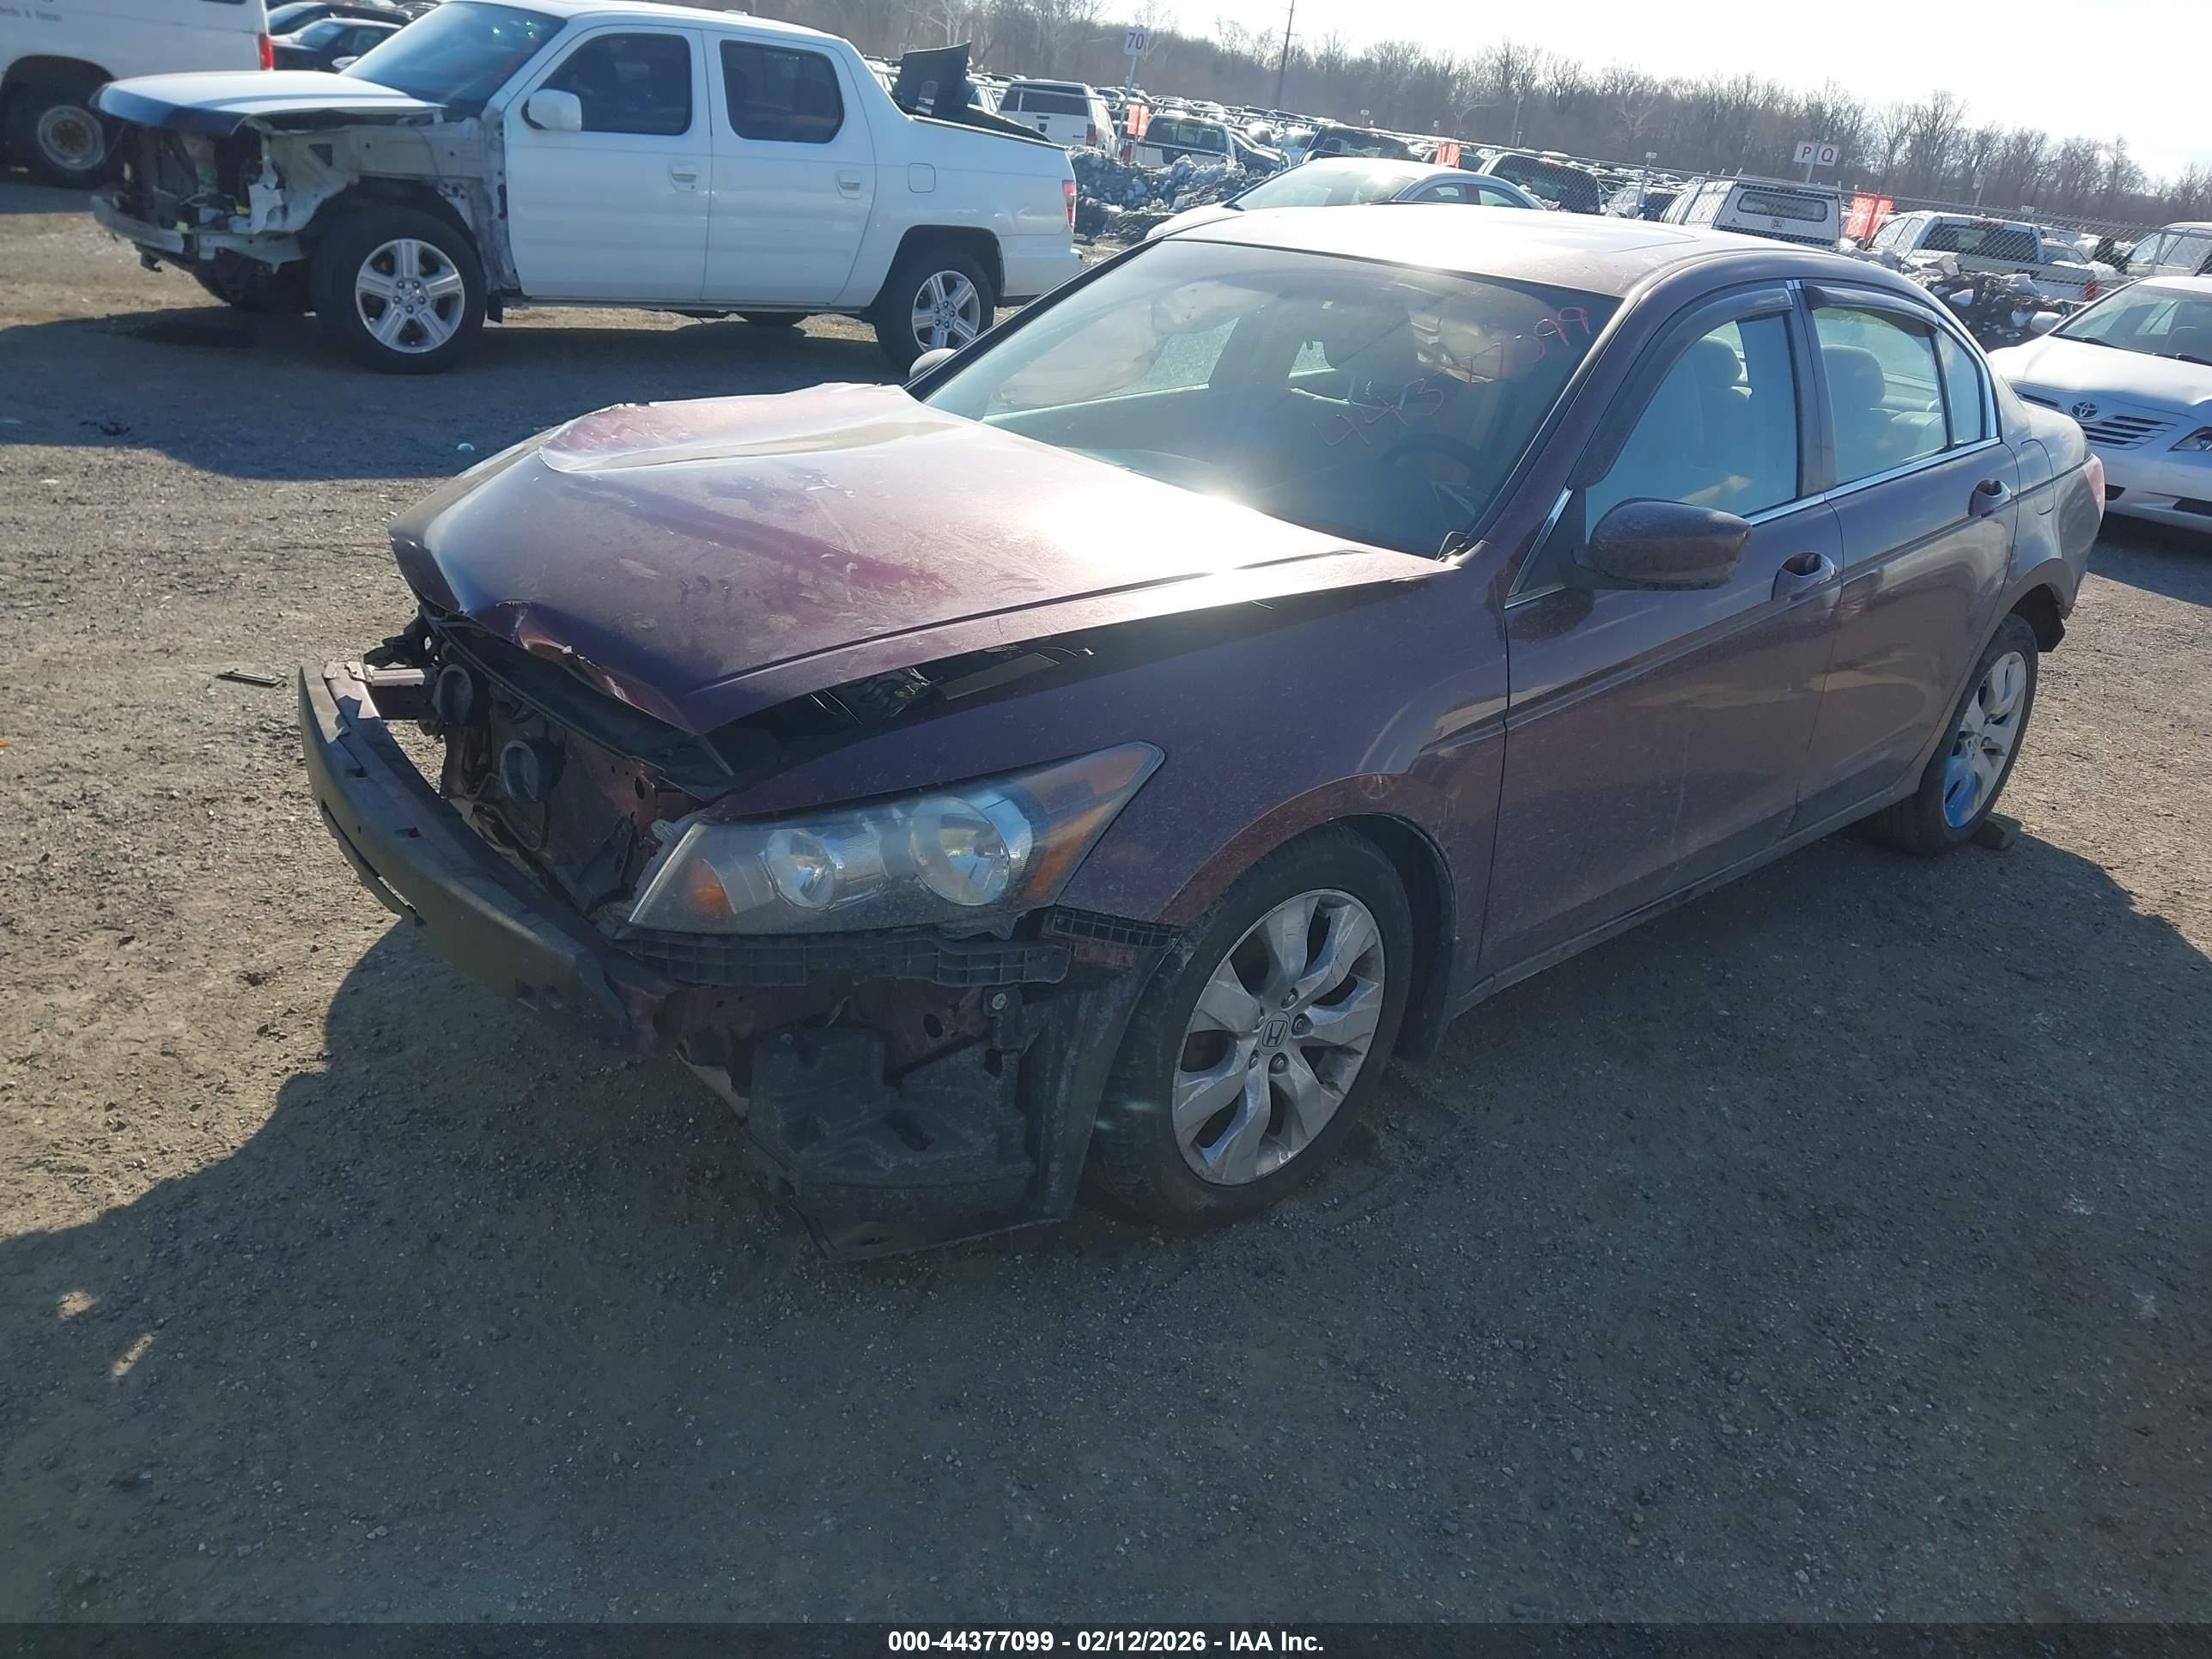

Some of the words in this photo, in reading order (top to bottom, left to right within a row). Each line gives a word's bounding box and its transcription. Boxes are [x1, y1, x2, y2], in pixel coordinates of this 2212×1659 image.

[1127, 32, 1145, 50] 70
[1801, 146, 1813, 159] P
[1820, 148, 1834, 162] Q
